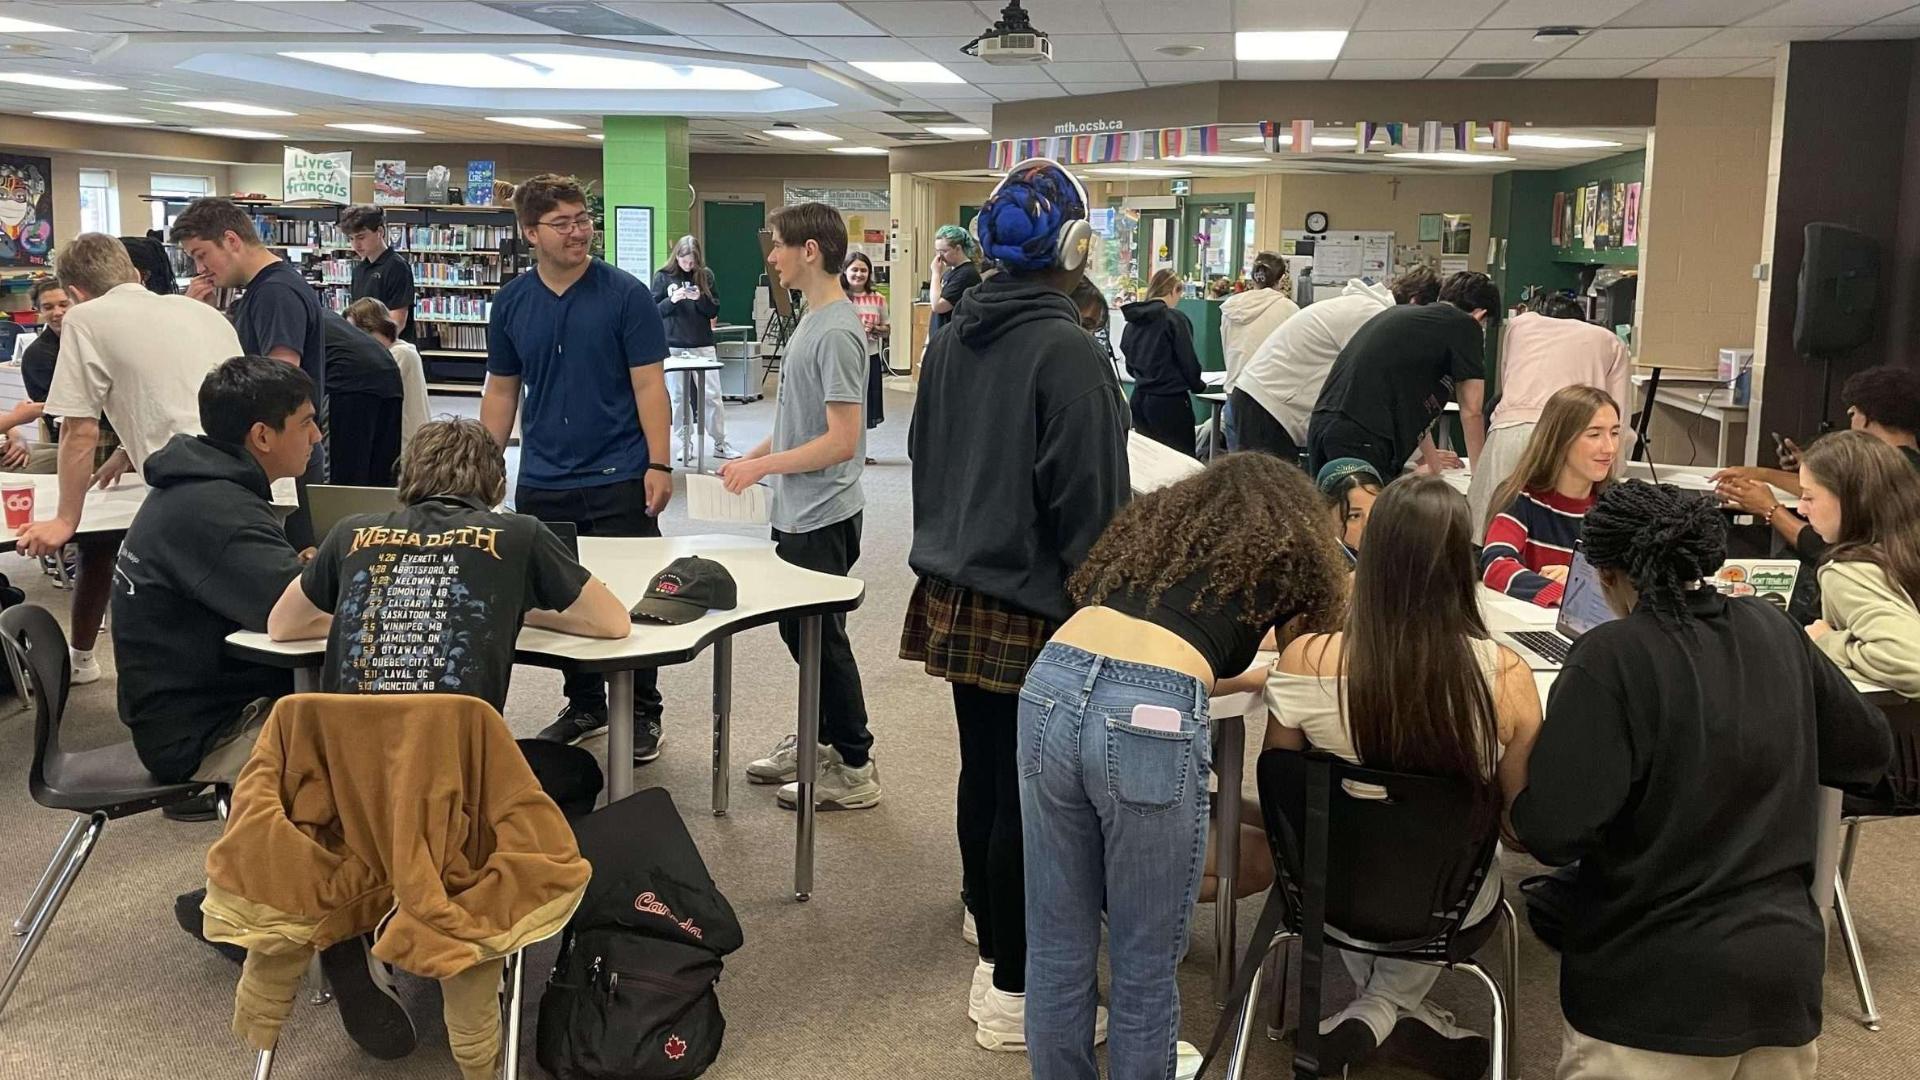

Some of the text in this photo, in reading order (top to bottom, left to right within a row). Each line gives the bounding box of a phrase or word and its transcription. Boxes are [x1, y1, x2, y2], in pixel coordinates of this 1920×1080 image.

[1054, 119, 1123, 134] mth.ocsb.ca
[294, 154, 342, 169] Livres
[307, 170, 327, 181] en
[286, 177, 347, 199] français
[345, 525, 504, 560] MEGADETH
[443, 554, 454, 562] WA
[436, 588, 448, 597] AB
[432, 600, 444, 608] AB
[435, 611, 447, 619] SK
[429, 623, 442, 631] MB
[428, 634, 440, 643] ON
[422, 646, 434, 654] ON
[423, 682, 435, 690] NB
[634, 891, 703, 939] Canda
